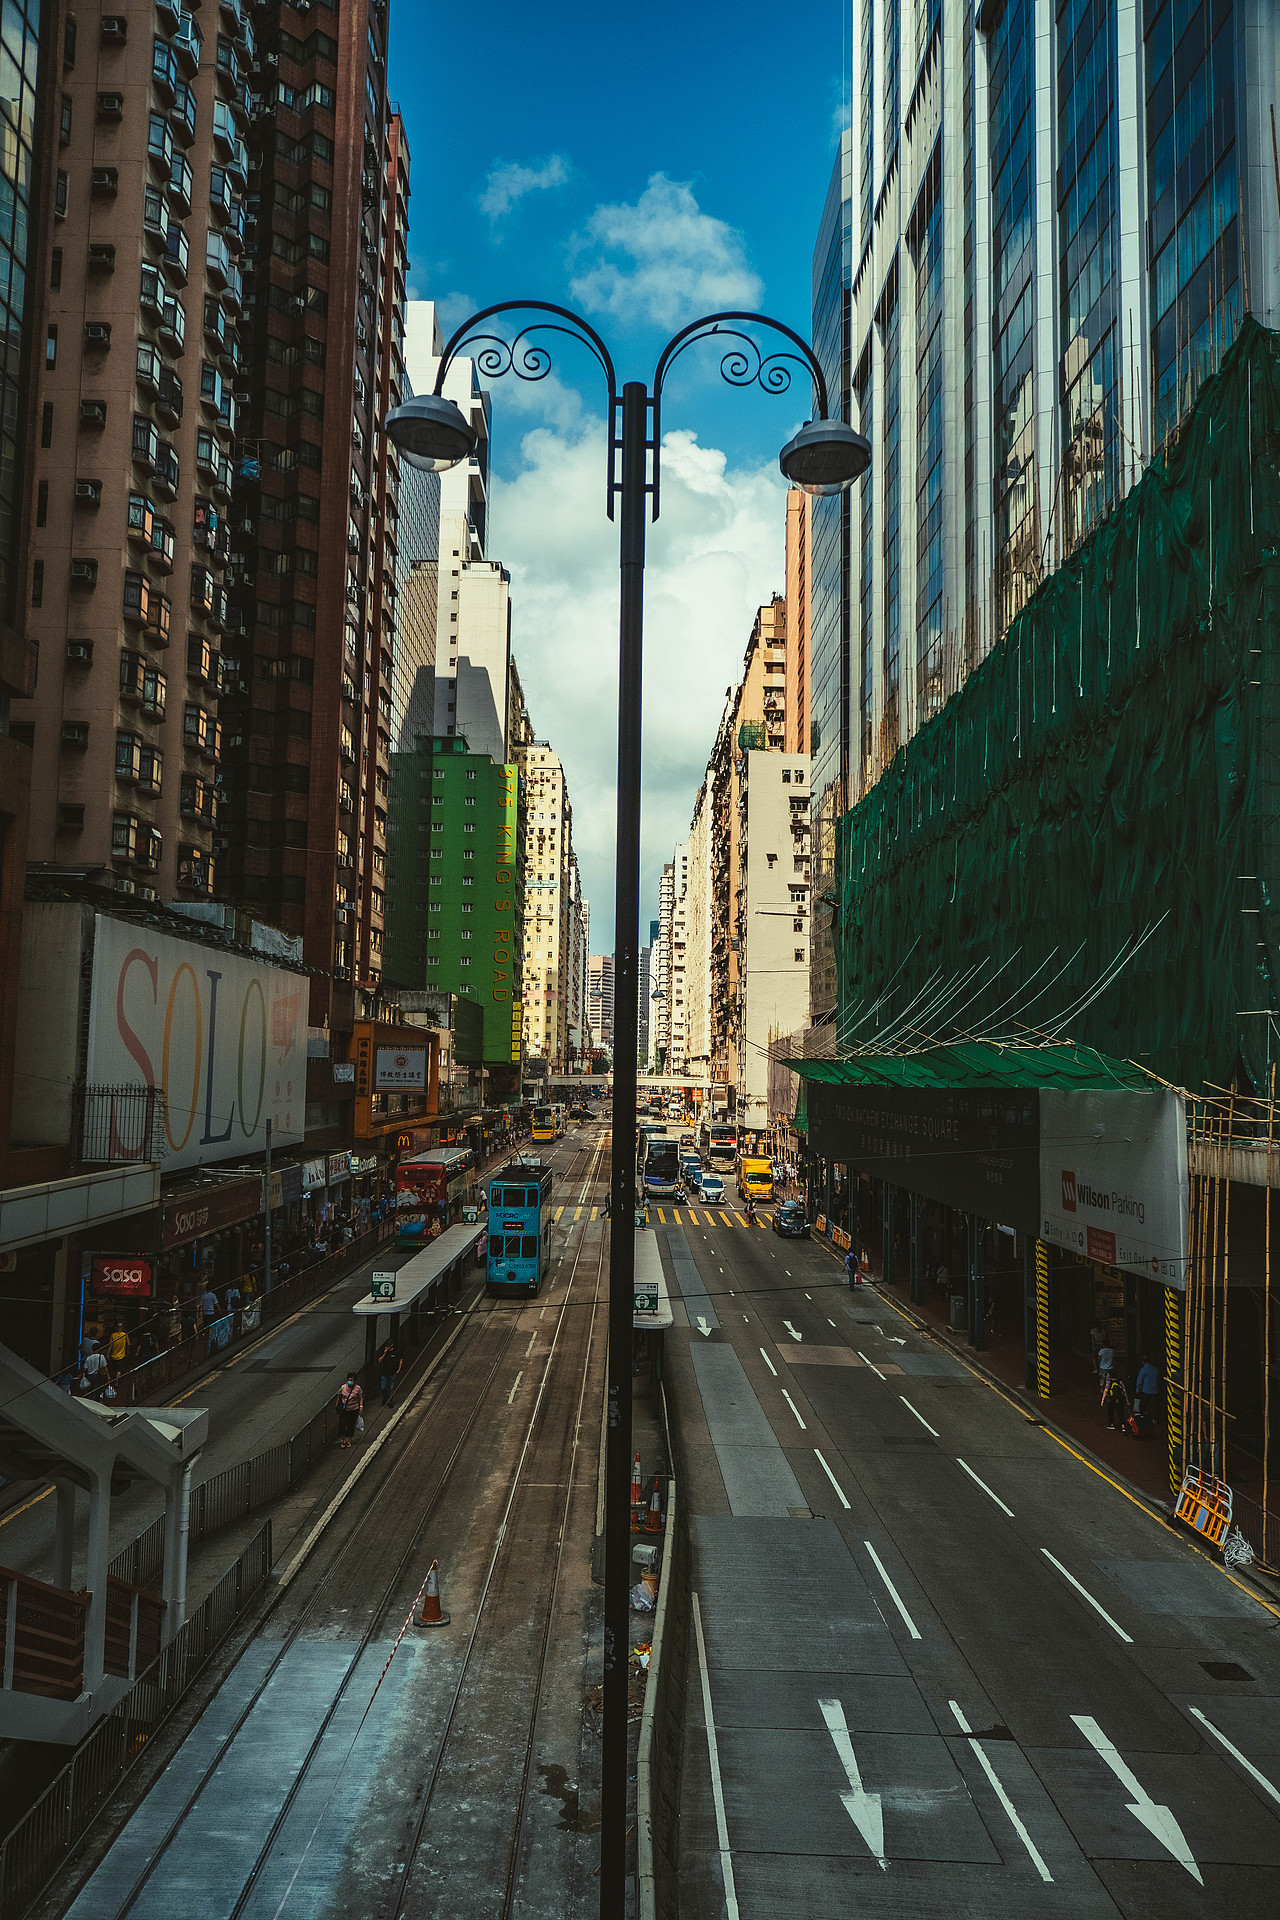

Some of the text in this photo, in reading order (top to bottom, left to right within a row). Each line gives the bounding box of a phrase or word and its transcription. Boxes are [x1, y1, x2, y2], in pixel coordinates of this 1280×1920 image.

[492, 768, 514, 1002] 375 KING'S ROAD
[111, 948, 266, 1159] SOLO
[881, 1111, 919, 1135] EXCHANGE
[922, 1115, 959, 1142] SQUARE
[1077, 1183, 1145, 1224] Wilson Parking
[1050, 1225, 1063, 1240] Entry
[1119, 1247, 1131, 1261] Exit
[1134, 1252, 1149, 1270] Only
